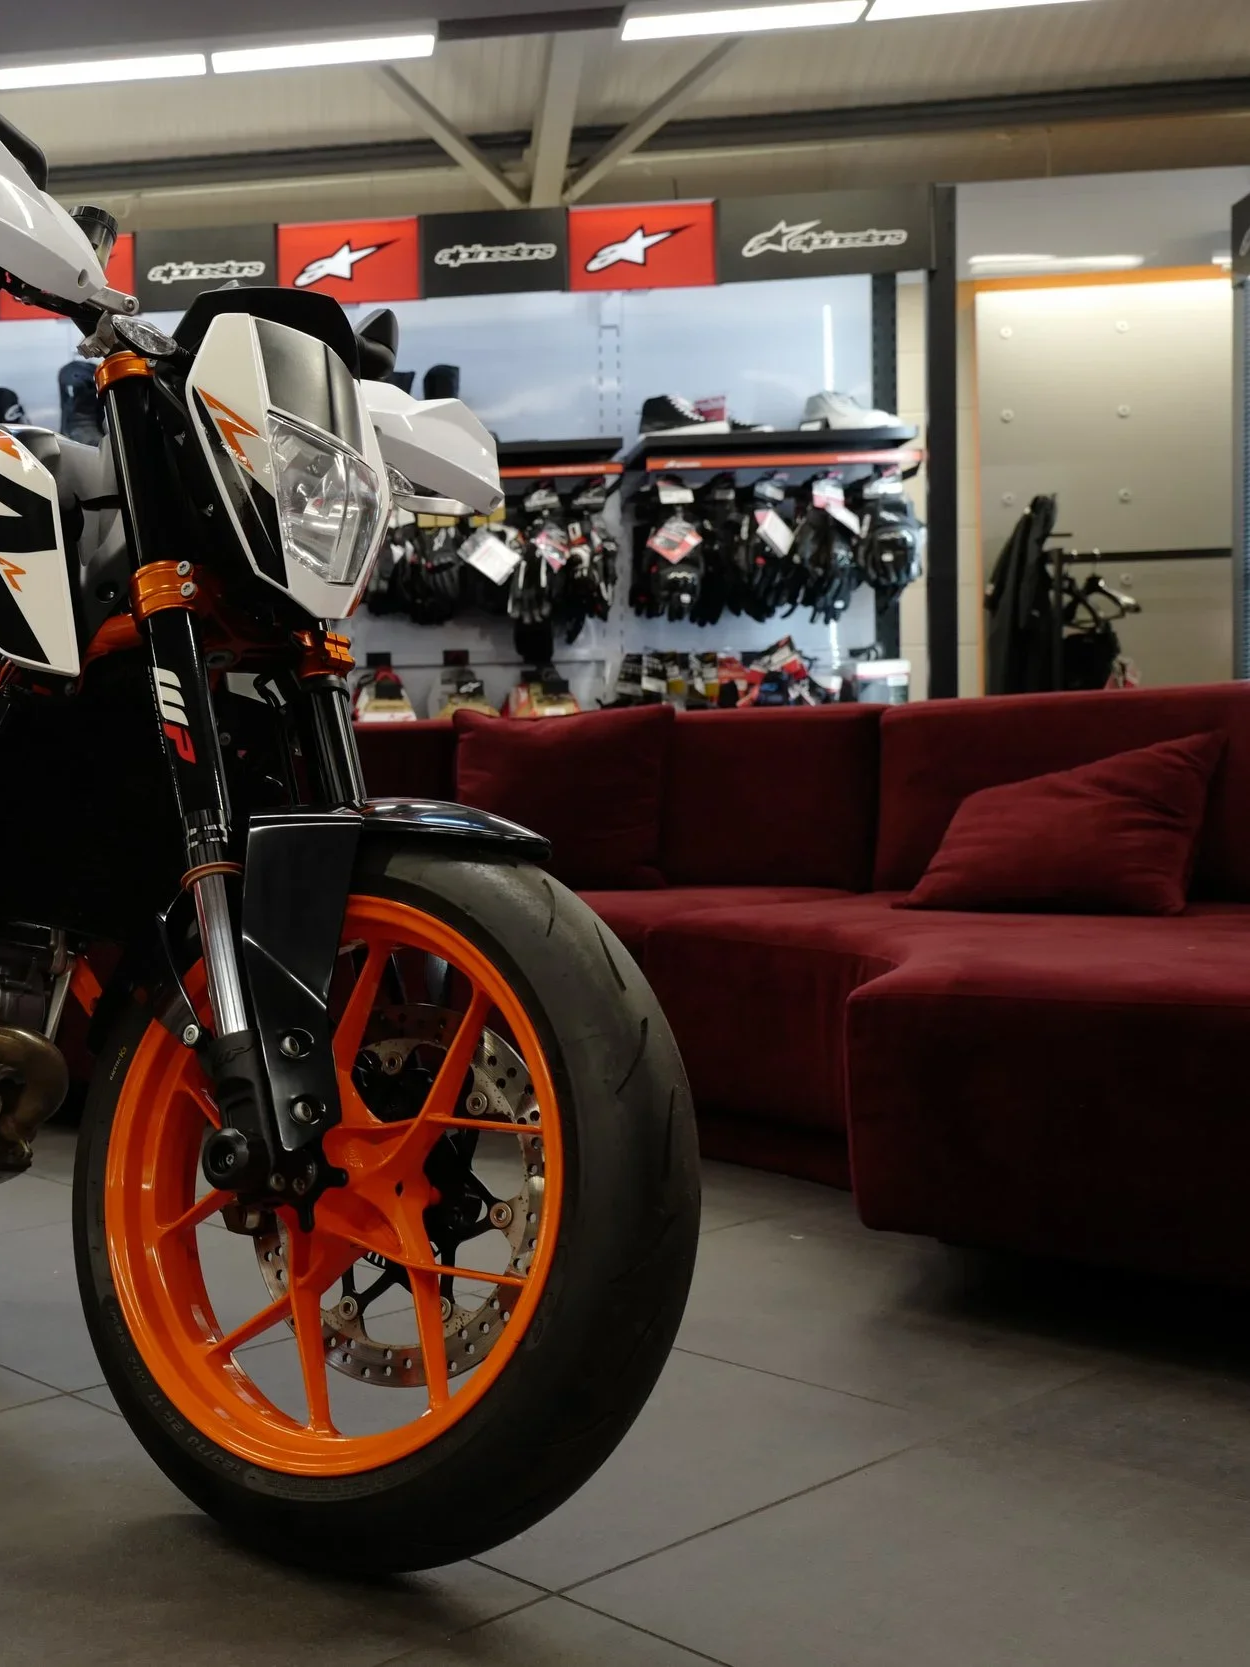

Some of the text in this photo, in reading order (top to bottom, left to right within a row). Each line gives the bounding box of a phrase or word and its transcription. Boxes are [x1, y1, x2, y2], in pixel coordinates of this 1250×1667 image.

[787, 229, 908, 254] alpinestars
[434, 243, 557, 267] alpinestars
[147, 260, 266, 284] alpinestars
